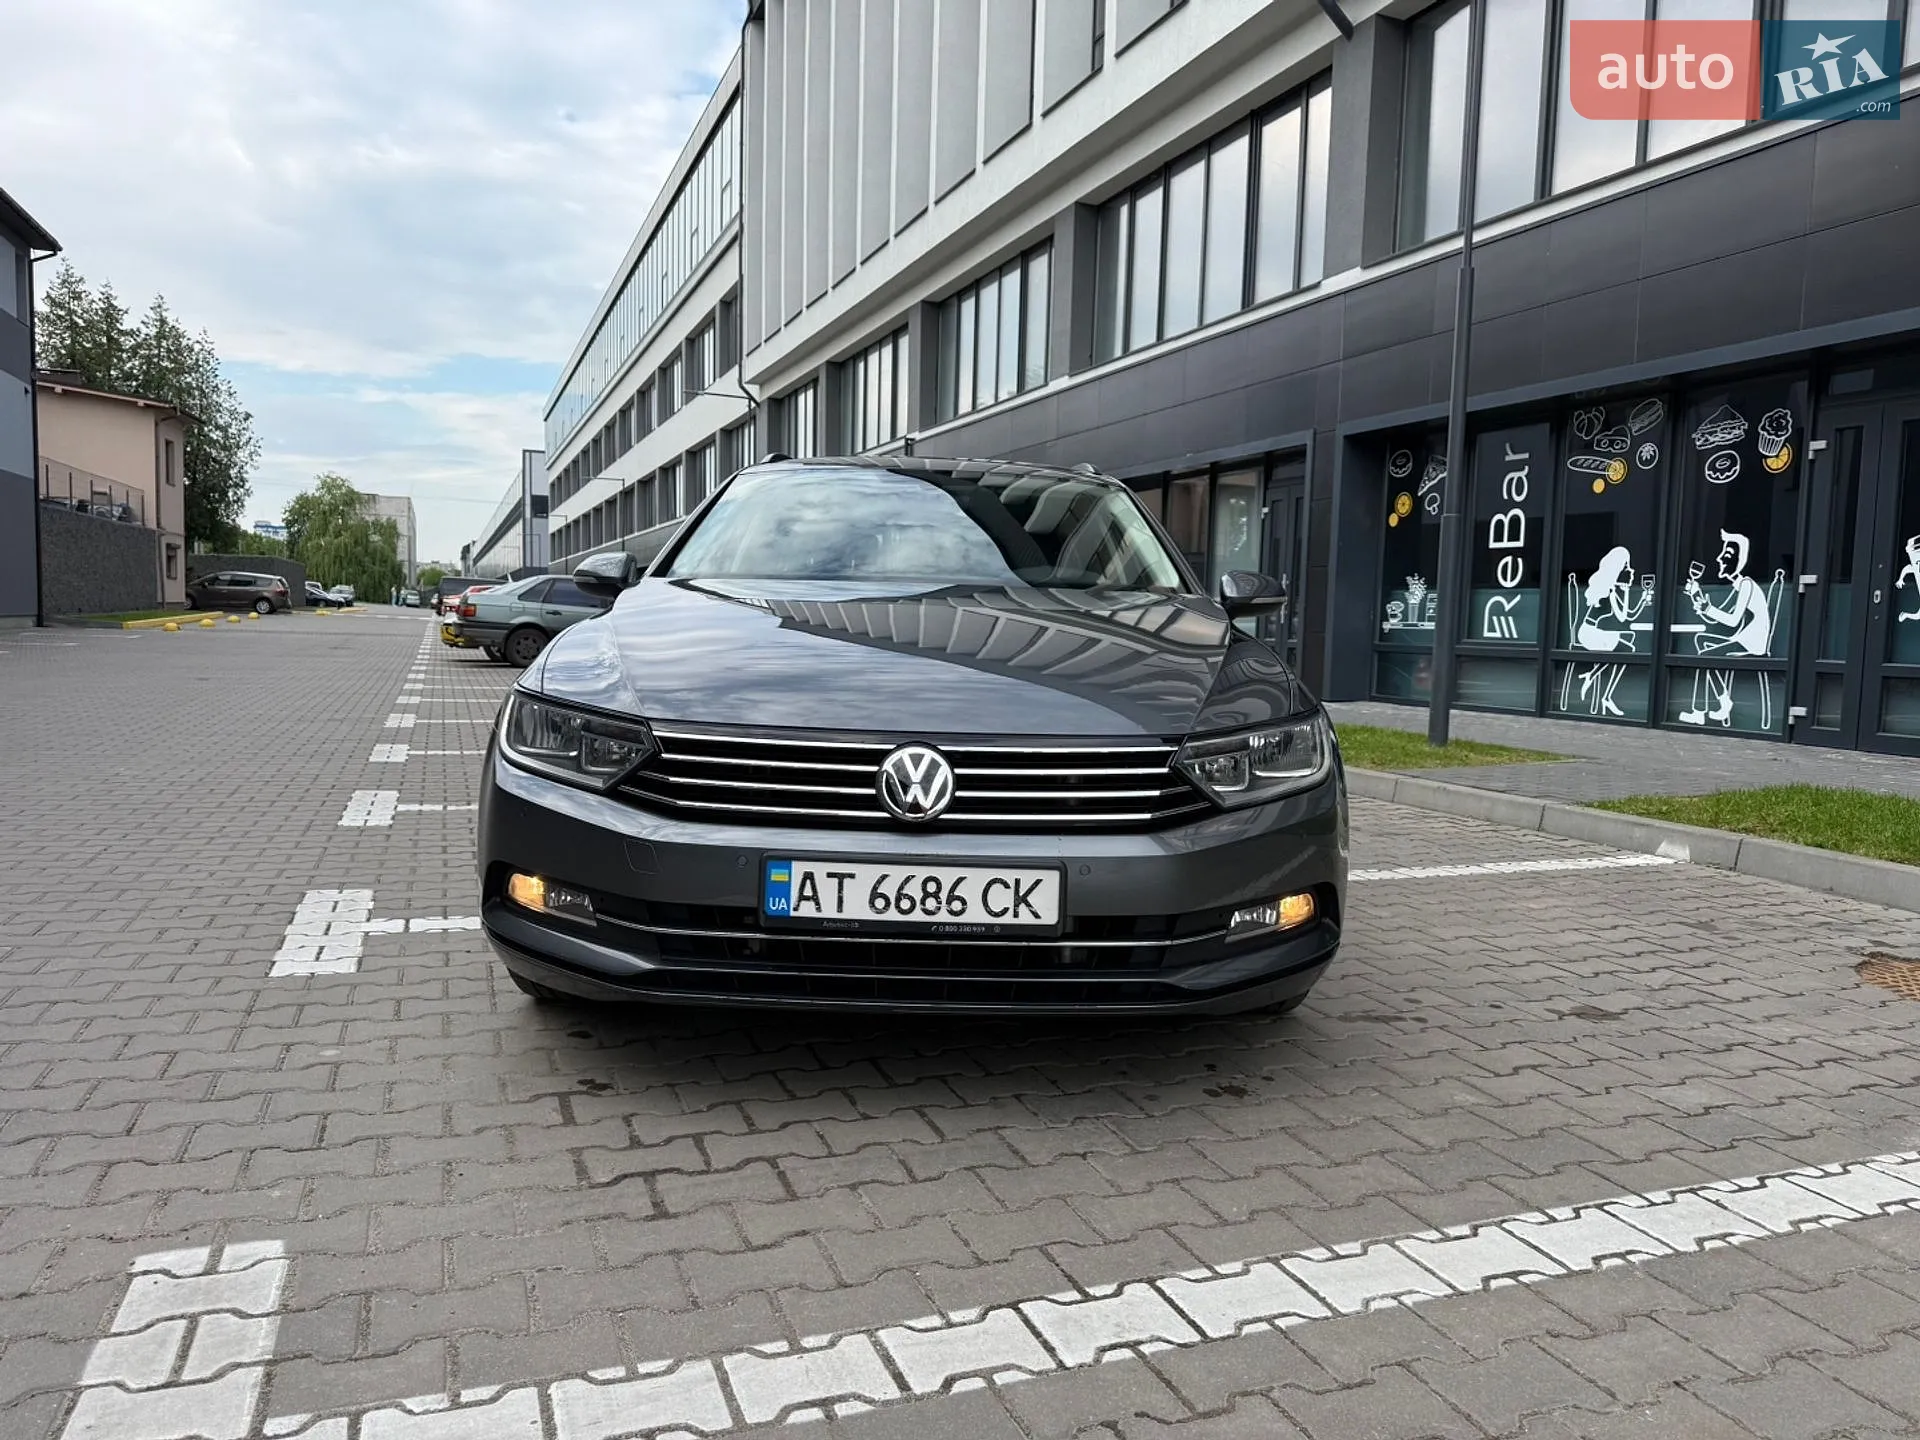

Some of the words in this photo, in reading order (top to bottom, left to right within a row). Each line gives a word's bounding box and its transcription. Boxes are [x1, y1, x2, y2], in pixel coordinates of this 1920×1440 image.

[1483, 443, 1530, 638] ReBar
[769, 897, 788, 911] UA
[793, 871, 856, 913] AT
[868, 873, 968, 917] 6686
[981, 877, 1043, 919] CK
